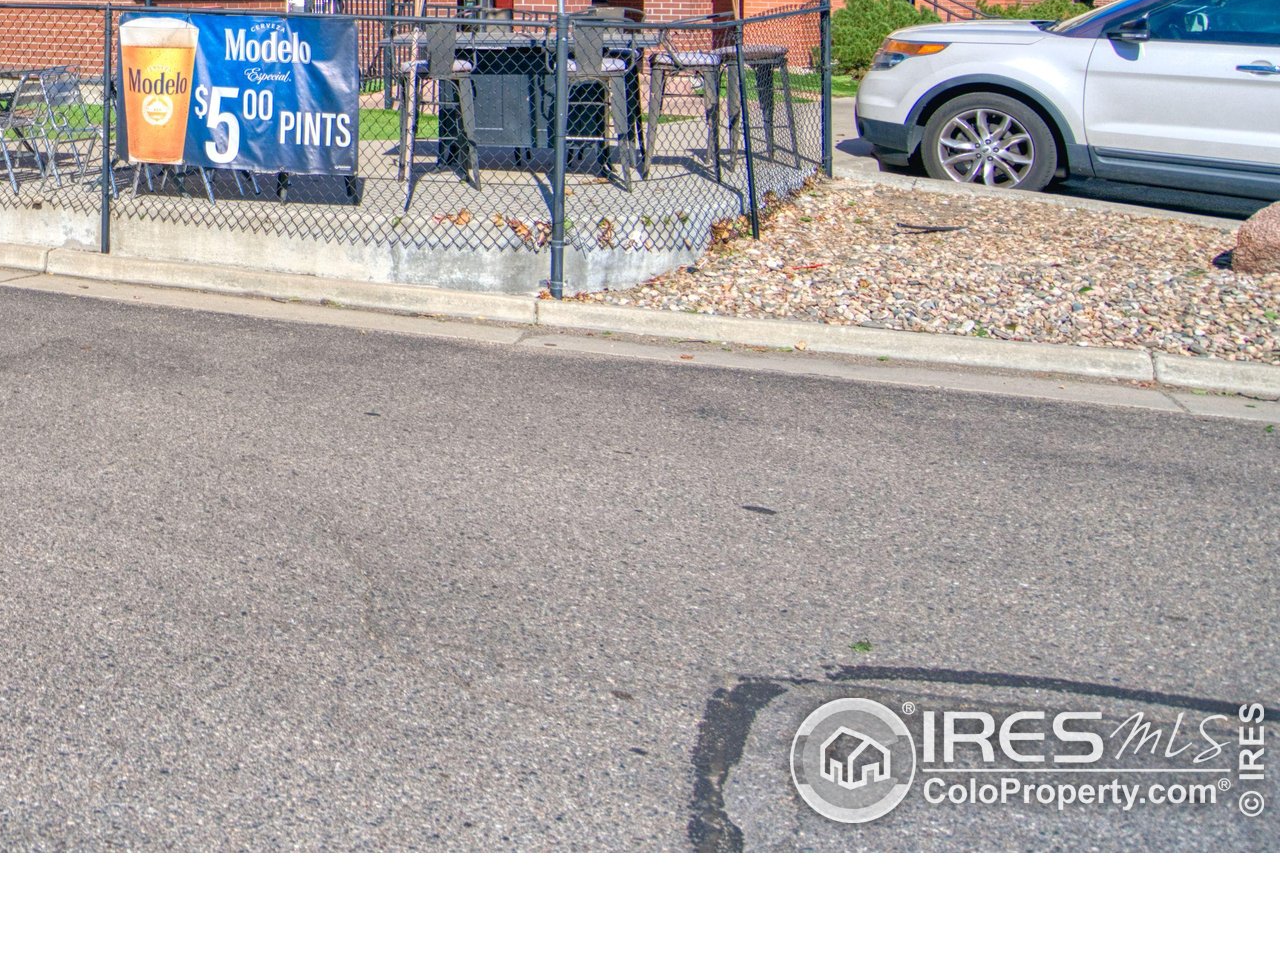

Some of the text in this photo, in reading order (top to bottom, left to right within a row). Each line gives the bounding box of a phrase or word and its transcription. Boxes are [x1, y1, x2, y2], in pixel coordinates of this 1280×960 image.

[251, 22, 286, 33] CERVEZA
[224, 28, 312, 64] Modelo
[129, 67, 188, 96] Modelo
[280, 111, 351, 148] PINTS
